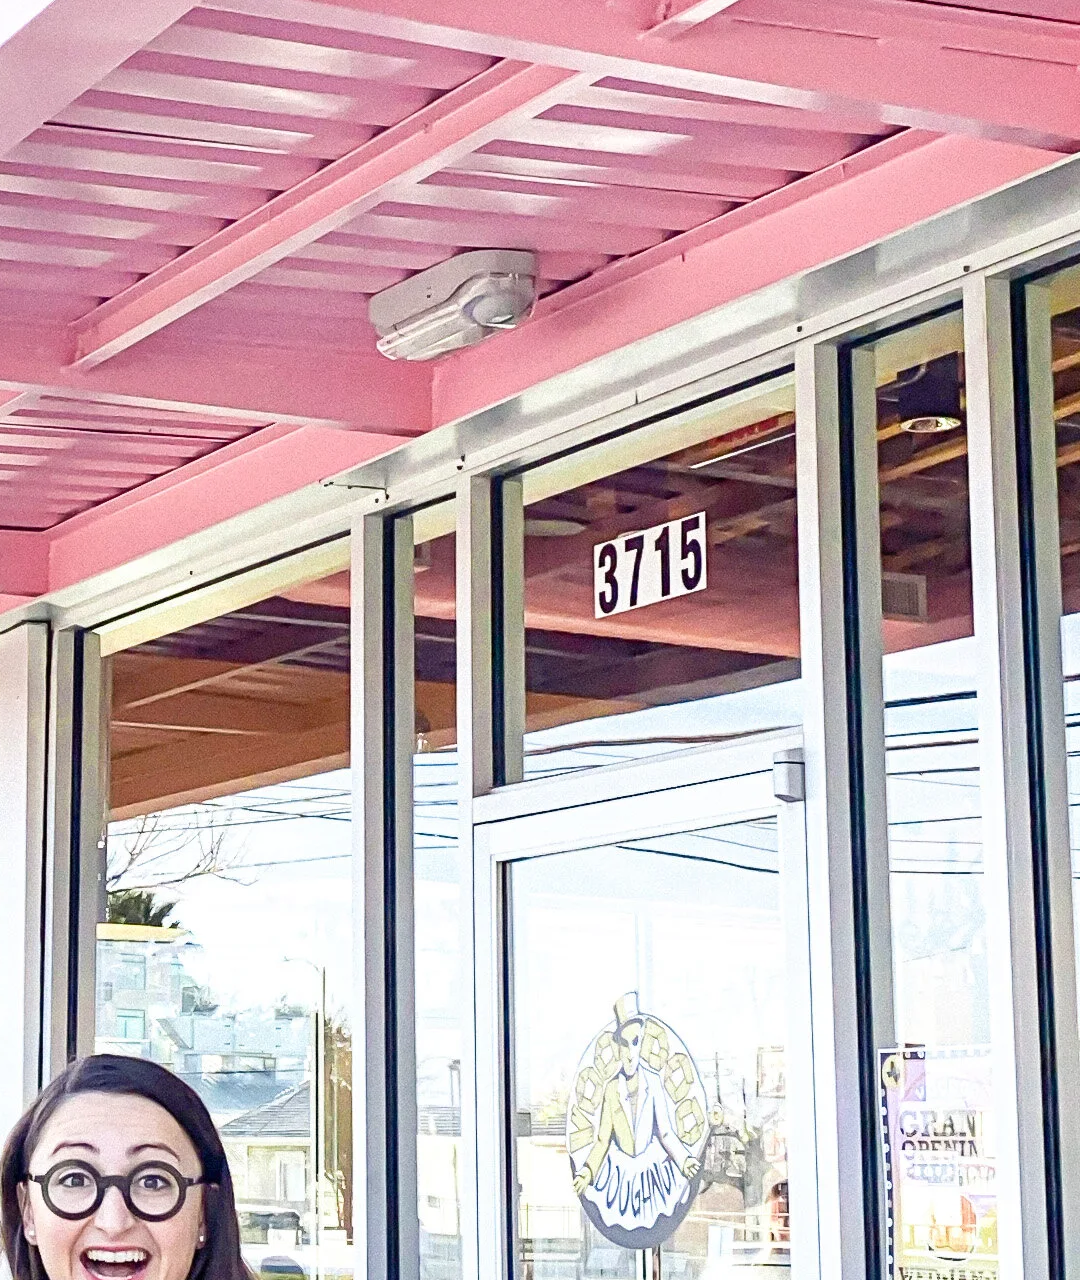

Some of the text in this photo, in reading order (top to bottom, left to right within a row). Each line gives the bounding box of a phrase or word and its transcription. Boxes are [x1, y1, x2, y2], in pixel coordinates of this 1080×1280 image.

[597, 515, 703, 614] 3715
[570, 1018, 705, 1154] VOODOO
[594, 1153, 678, 1220] DOUGHNUT
